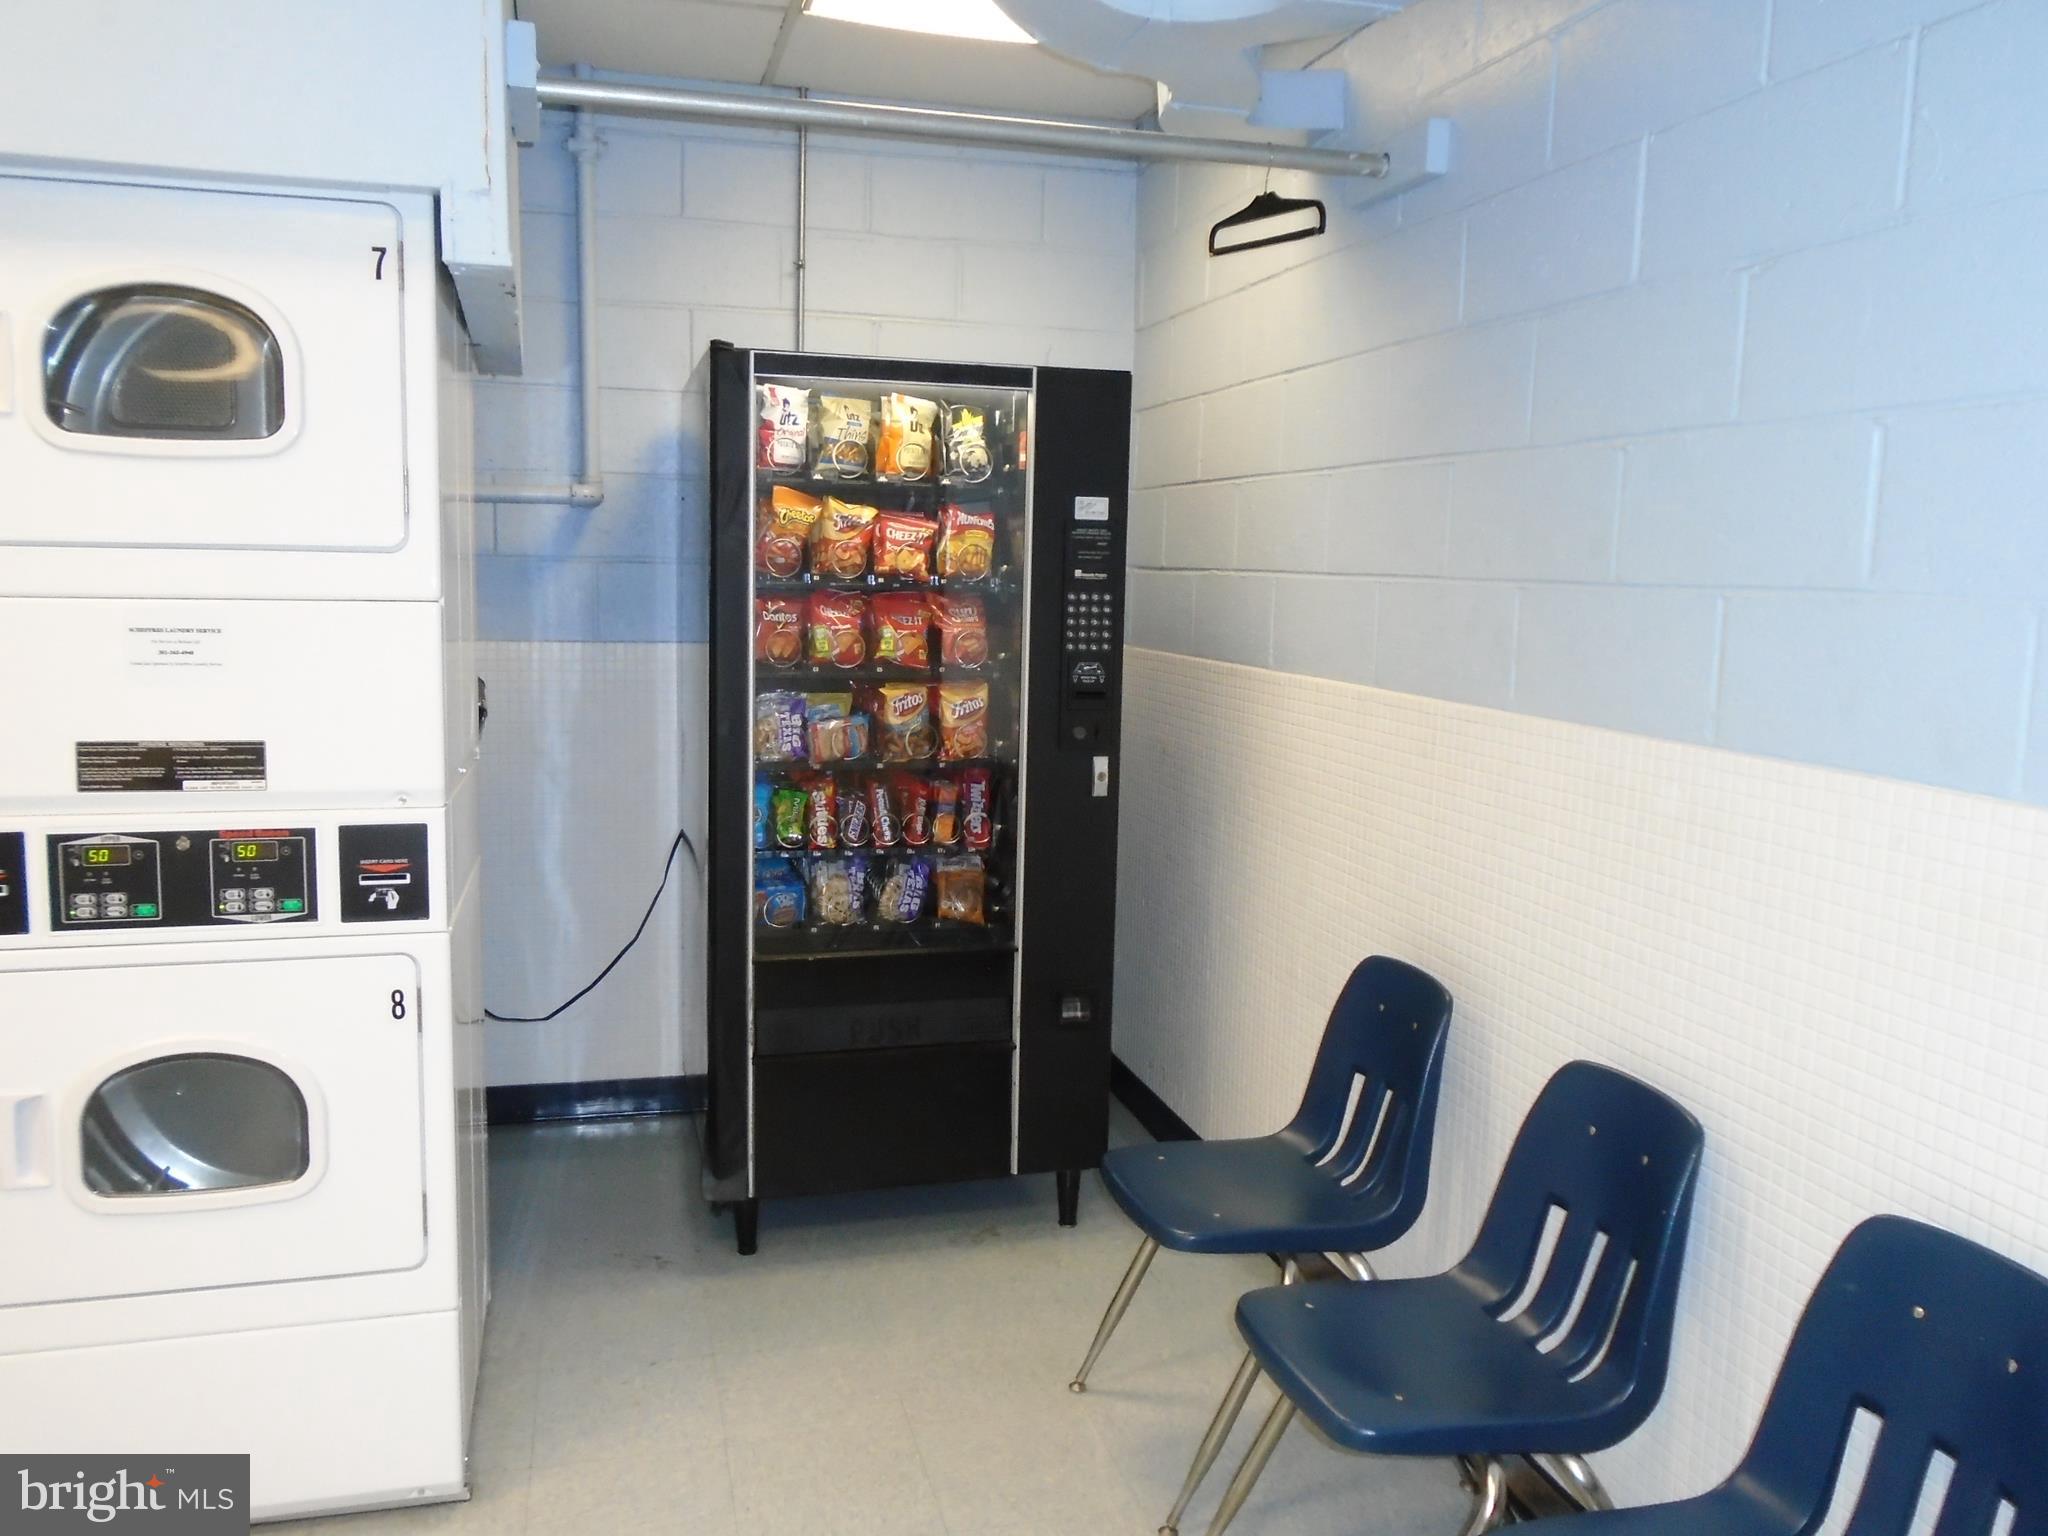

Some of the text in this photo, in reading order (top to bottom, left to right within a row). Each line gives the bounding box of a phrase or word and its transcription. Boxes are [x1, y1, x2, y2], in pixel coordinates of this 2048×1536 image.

[371, 246, 387, 280] 7
[762, 610, 798, 623] Doritos
[88, 849, 110, 863] 50
[237, 844, 257, 858] 50
[391, 989, 406, 1020] 8
